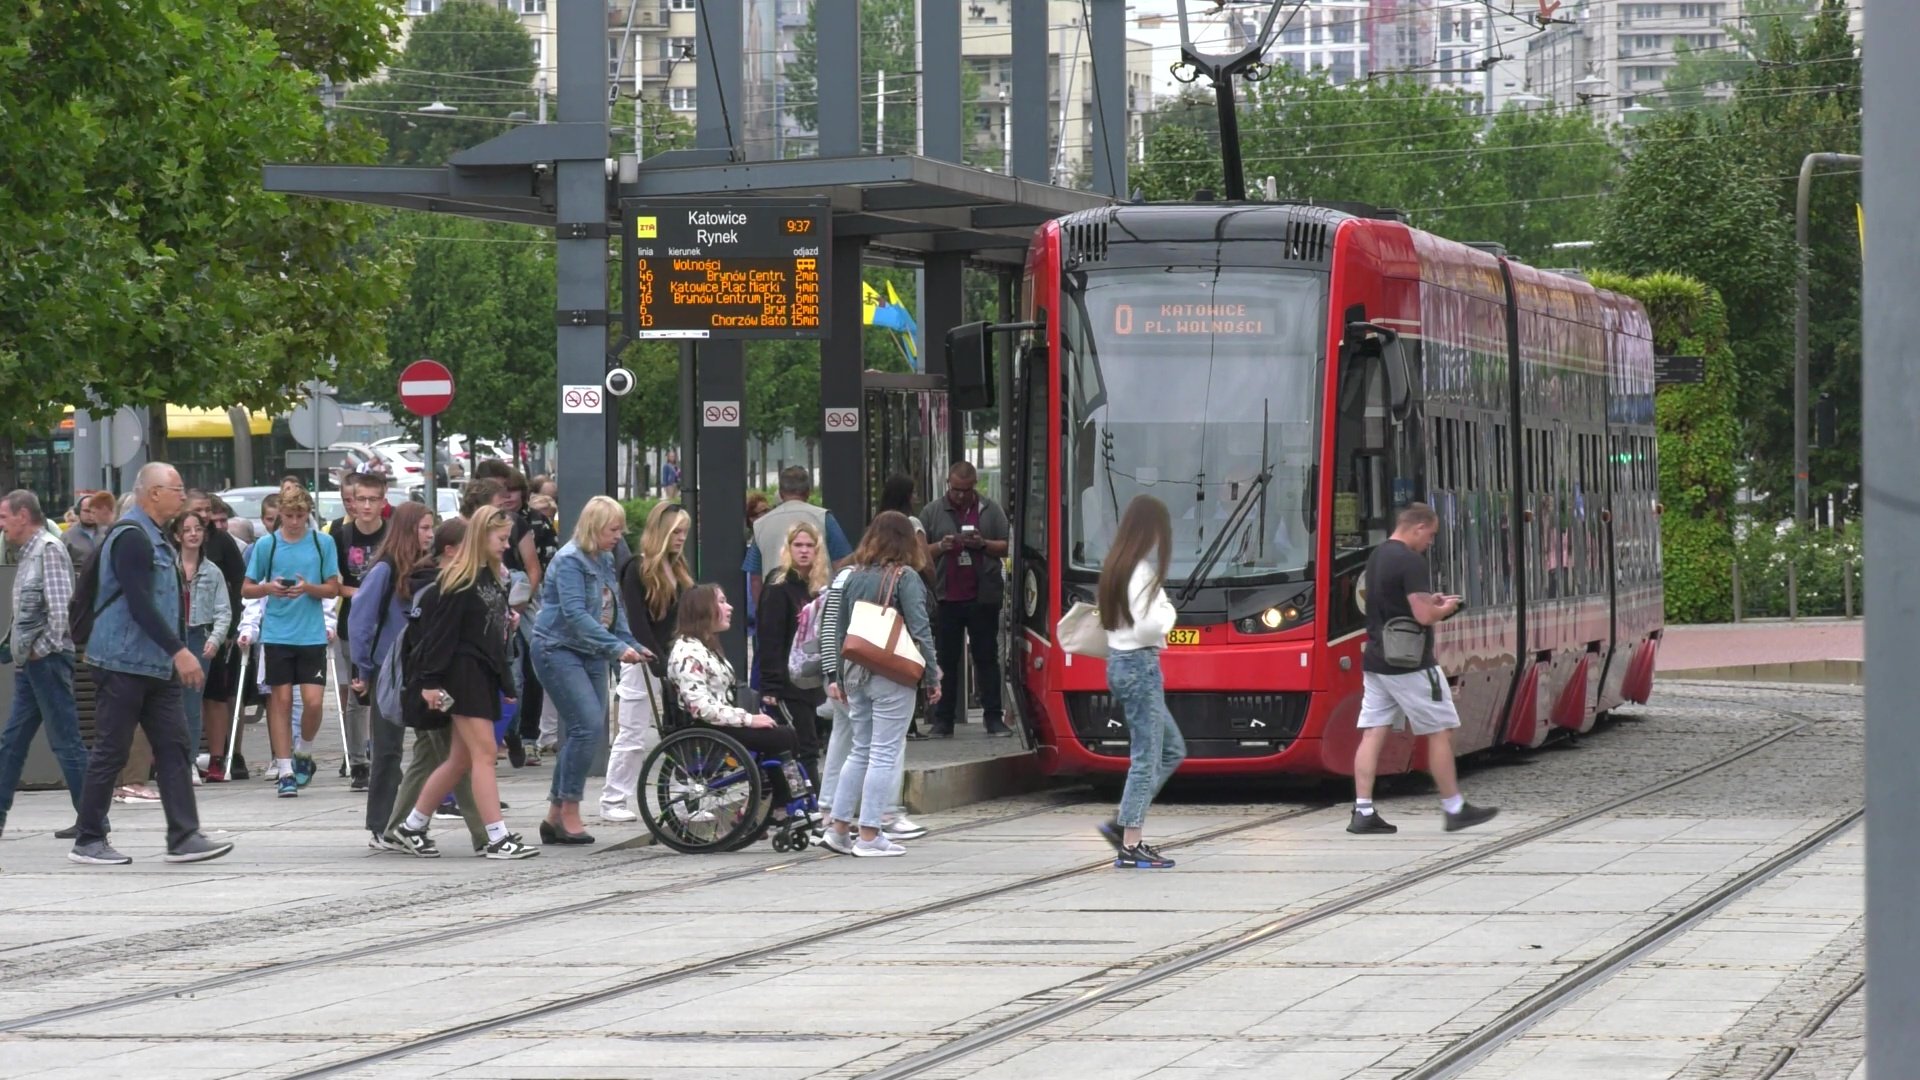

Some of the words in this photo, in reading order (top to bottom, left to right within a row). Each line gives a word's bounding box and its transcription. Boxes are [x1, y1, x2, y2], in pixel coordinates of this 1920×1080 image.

[688, 210, 747, 225] Katowice
[787, 220, 811, 232] 9:37
[697, 229, 738, 247] Rynek
[637, 247, 654, 256] linia
[668, 247, 701, 256] kierunek
[793, 246, 819, 257] odjazd
[639, 259, 647, 271] 0
[673, 258, 721, 271] Wolności
[639, 270, 654, 282] 46
[707, 269, 746, 282] Brynów
[795, 269, 819, 282] 2min
[639, 281, 652, 293] 41
[670, 281, 719, 293] Katowice
[721, 281, 746, 293] Plac
[749, 281, 780, 293] Miarki
[795, 281, 819, 293] 4min
[640, 293, 653, 304] 16
[673, 292, 714, 304] Brynów
[716, 292, 761, 304] Centrum
[795, 292, 819, 304] 6min
[639, 303, 647, 315] 6
[790, 303, 819, 315] 12min
[640, 314, 653, 326] 13
[711, 314, 758, 326] Chorzów
[761, 314, 787, 326] Bato
[790, 314, 819, 326] 15min
[1115, 304, 1133, 335] 0
[1161, 304, 1246, 317] KATOWICE
[1144, 321, 1171, 333] PL.
[1176, 320, 1262, 333] WOLNOŚCI
[1169, 630, 1197, 643] 837
